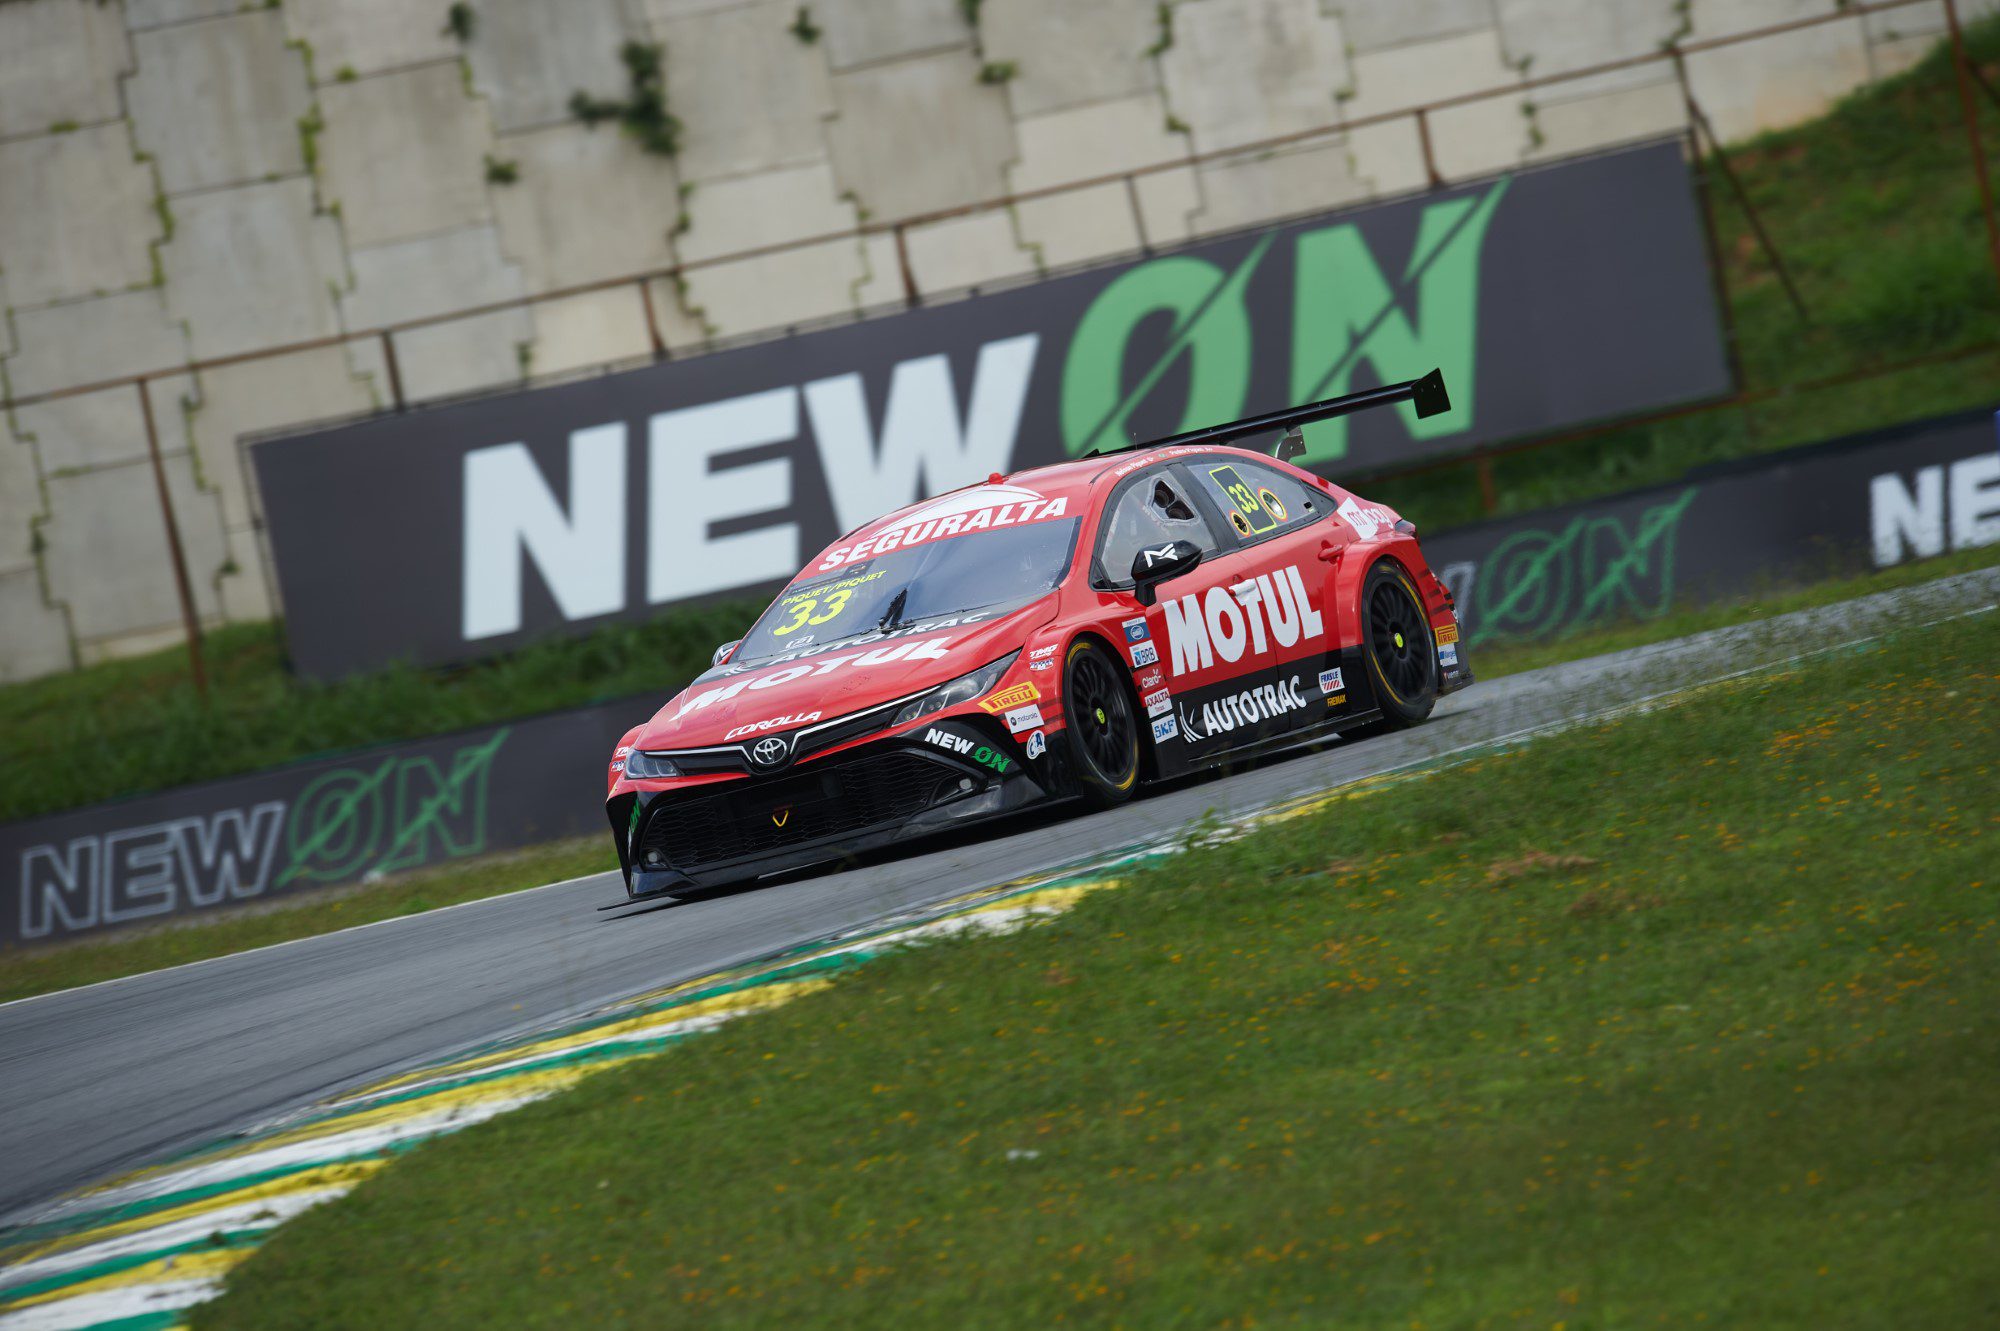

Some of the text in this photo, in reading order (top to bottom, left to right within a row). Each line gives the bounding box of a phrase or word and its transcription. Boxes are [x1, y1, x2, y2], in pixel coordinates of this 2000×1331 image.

[461, 333, 1039, 641] NEW
[1228, 484, 1259, 514] 33
[819, 497, 1068, 571] SEGURALTA
[774, 589, 852, 636] 33
[1162, 565, 1324, 677] MOTUL
[1437, 626, 1458, 645] PIRELLI
[1141, 647, 1156, 664] BRB
[669, 636, 951, 721] MOTUL
[1142, 672, 1161, 688] Claro
[984, 684, 1034, 710] PIRELLI
[1146, 690, 1170, 707] AXALTA
[1203, 675, 1307, 737] AUTOTRAC
[723, 711, 822, 741] COROLLA
[1017, 711, 1039, 722] motorola
[1154, 719, 1175, 738] SKF
[925, 728, 975, 755] NEW
[19, 802, 286, 939] NEW
